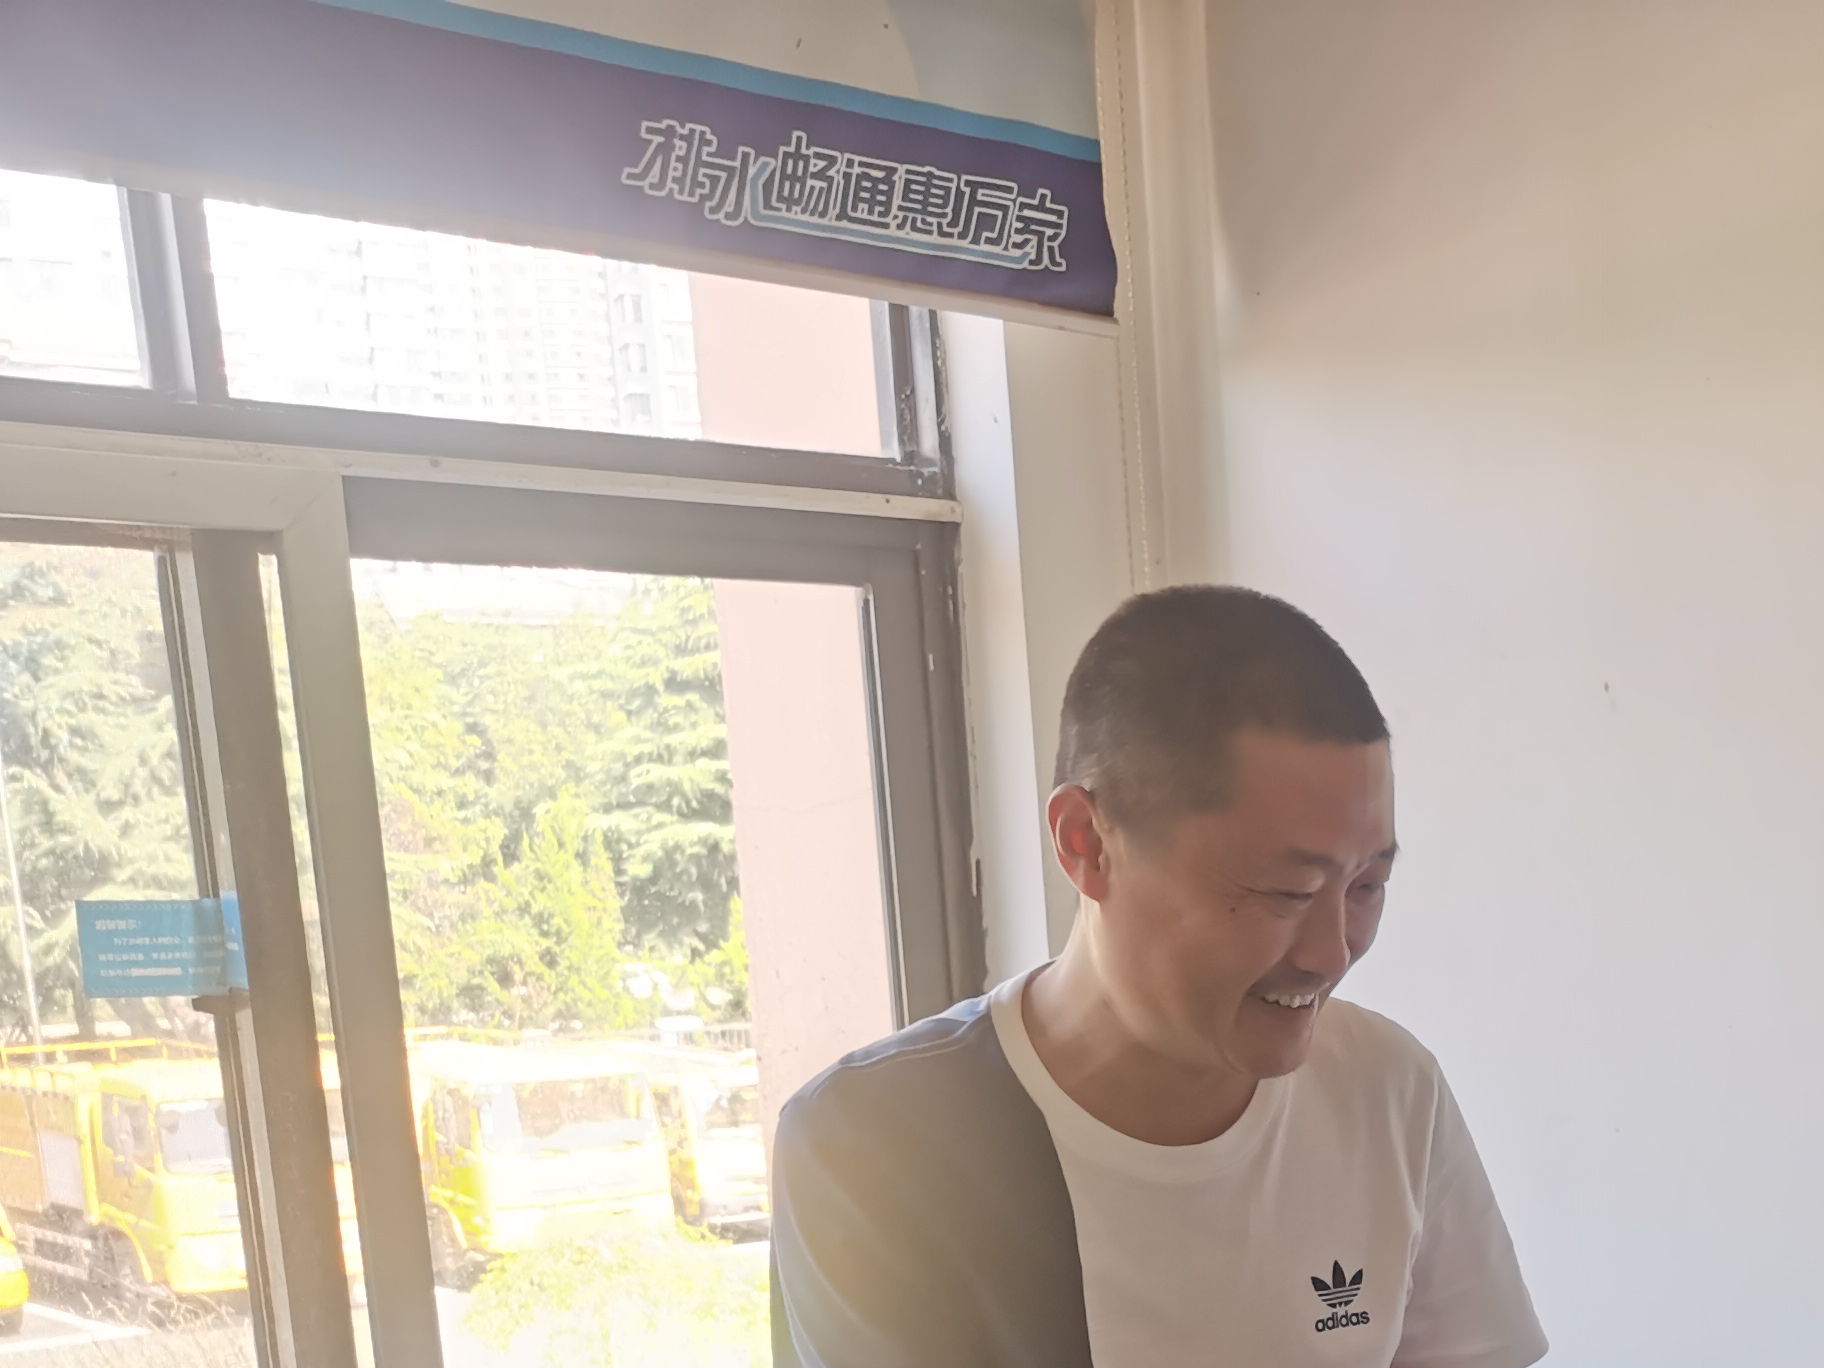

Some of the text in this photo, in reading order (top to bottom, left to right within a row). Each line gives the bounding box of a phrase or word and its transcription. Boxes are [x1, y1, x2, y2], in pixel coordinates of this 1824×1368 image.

[622, 118, 1070, 273] 排水畅通惠万家
[1314, 1309, 1371, 1333] adidas
